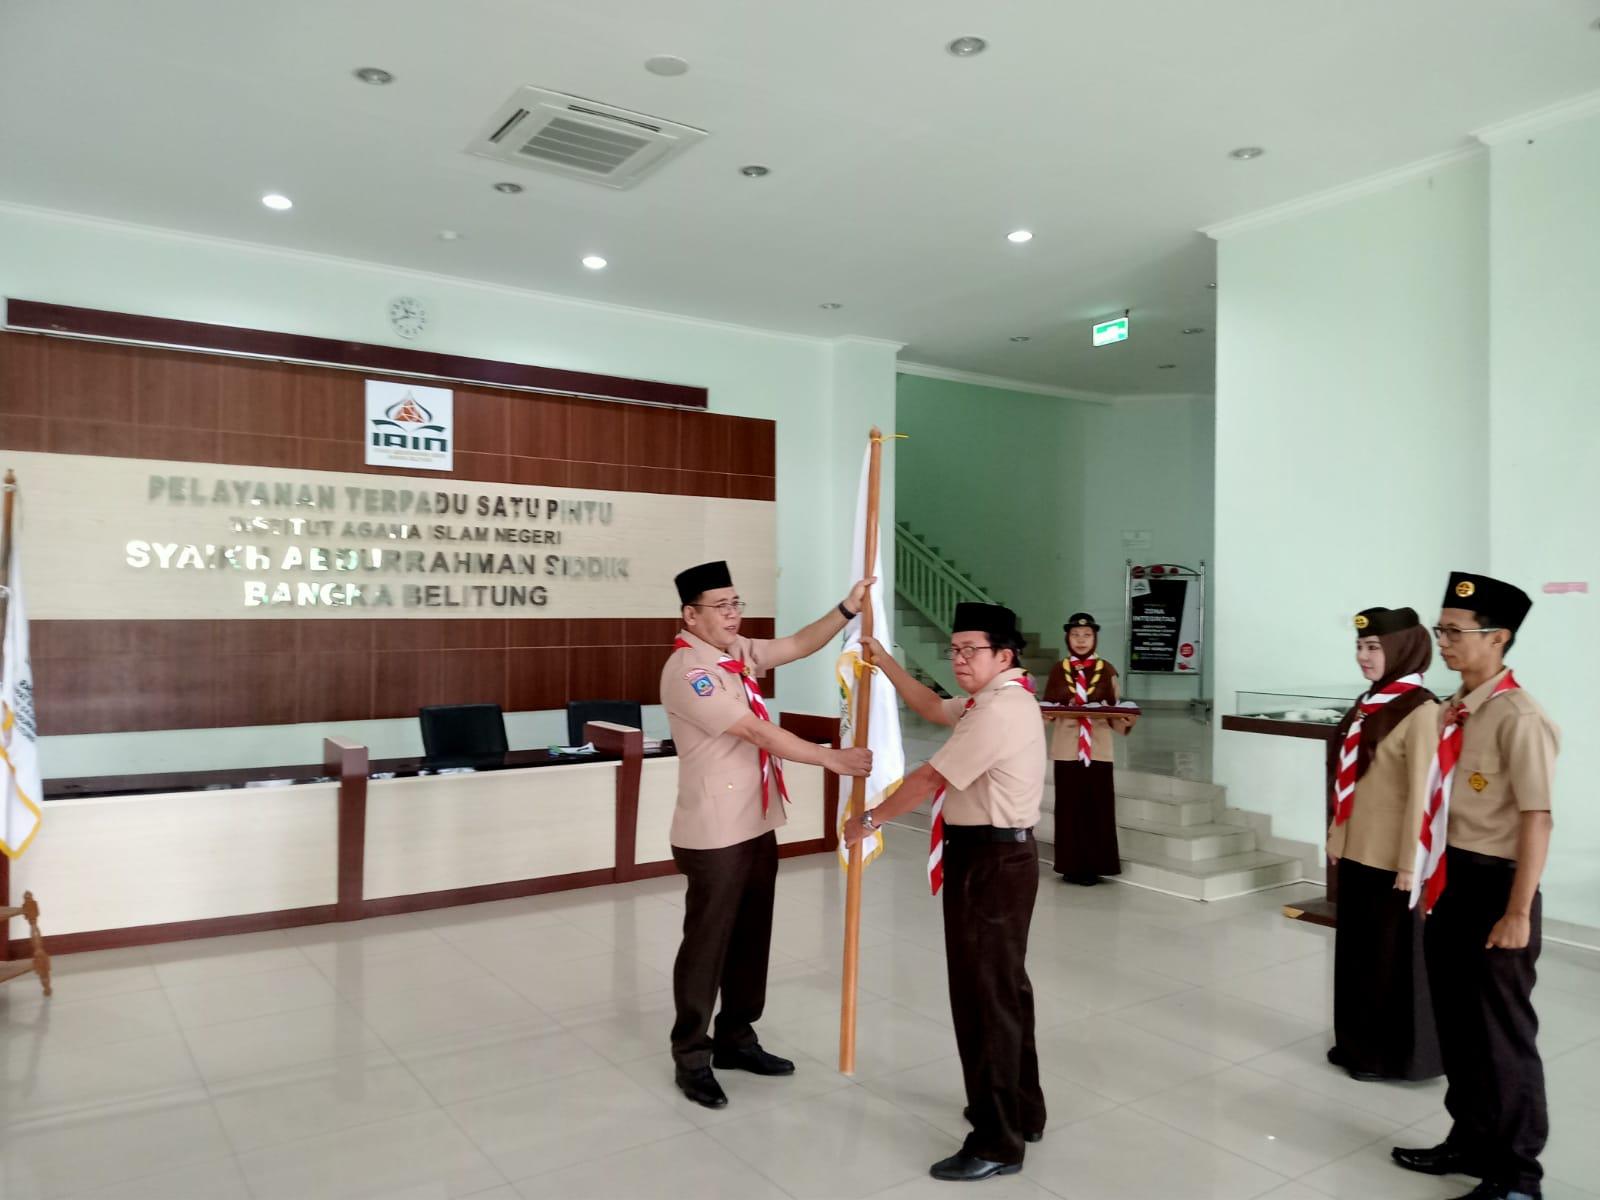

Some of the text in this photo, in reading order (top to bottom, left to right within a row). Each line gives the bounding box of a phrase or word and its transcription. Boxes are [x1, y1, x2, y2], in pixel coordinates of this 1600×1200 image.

[149, 475, 612, 525] PELAYANAN TERPADU SATU PINTU
[494, 527, 561, 546] NEGERI
[281, 546, 535, 575] ABDURRAHMAN
[545, 554, 630, 577] SIDDIK
[244, 580, 548, 608] BANGKA BELITUNG
